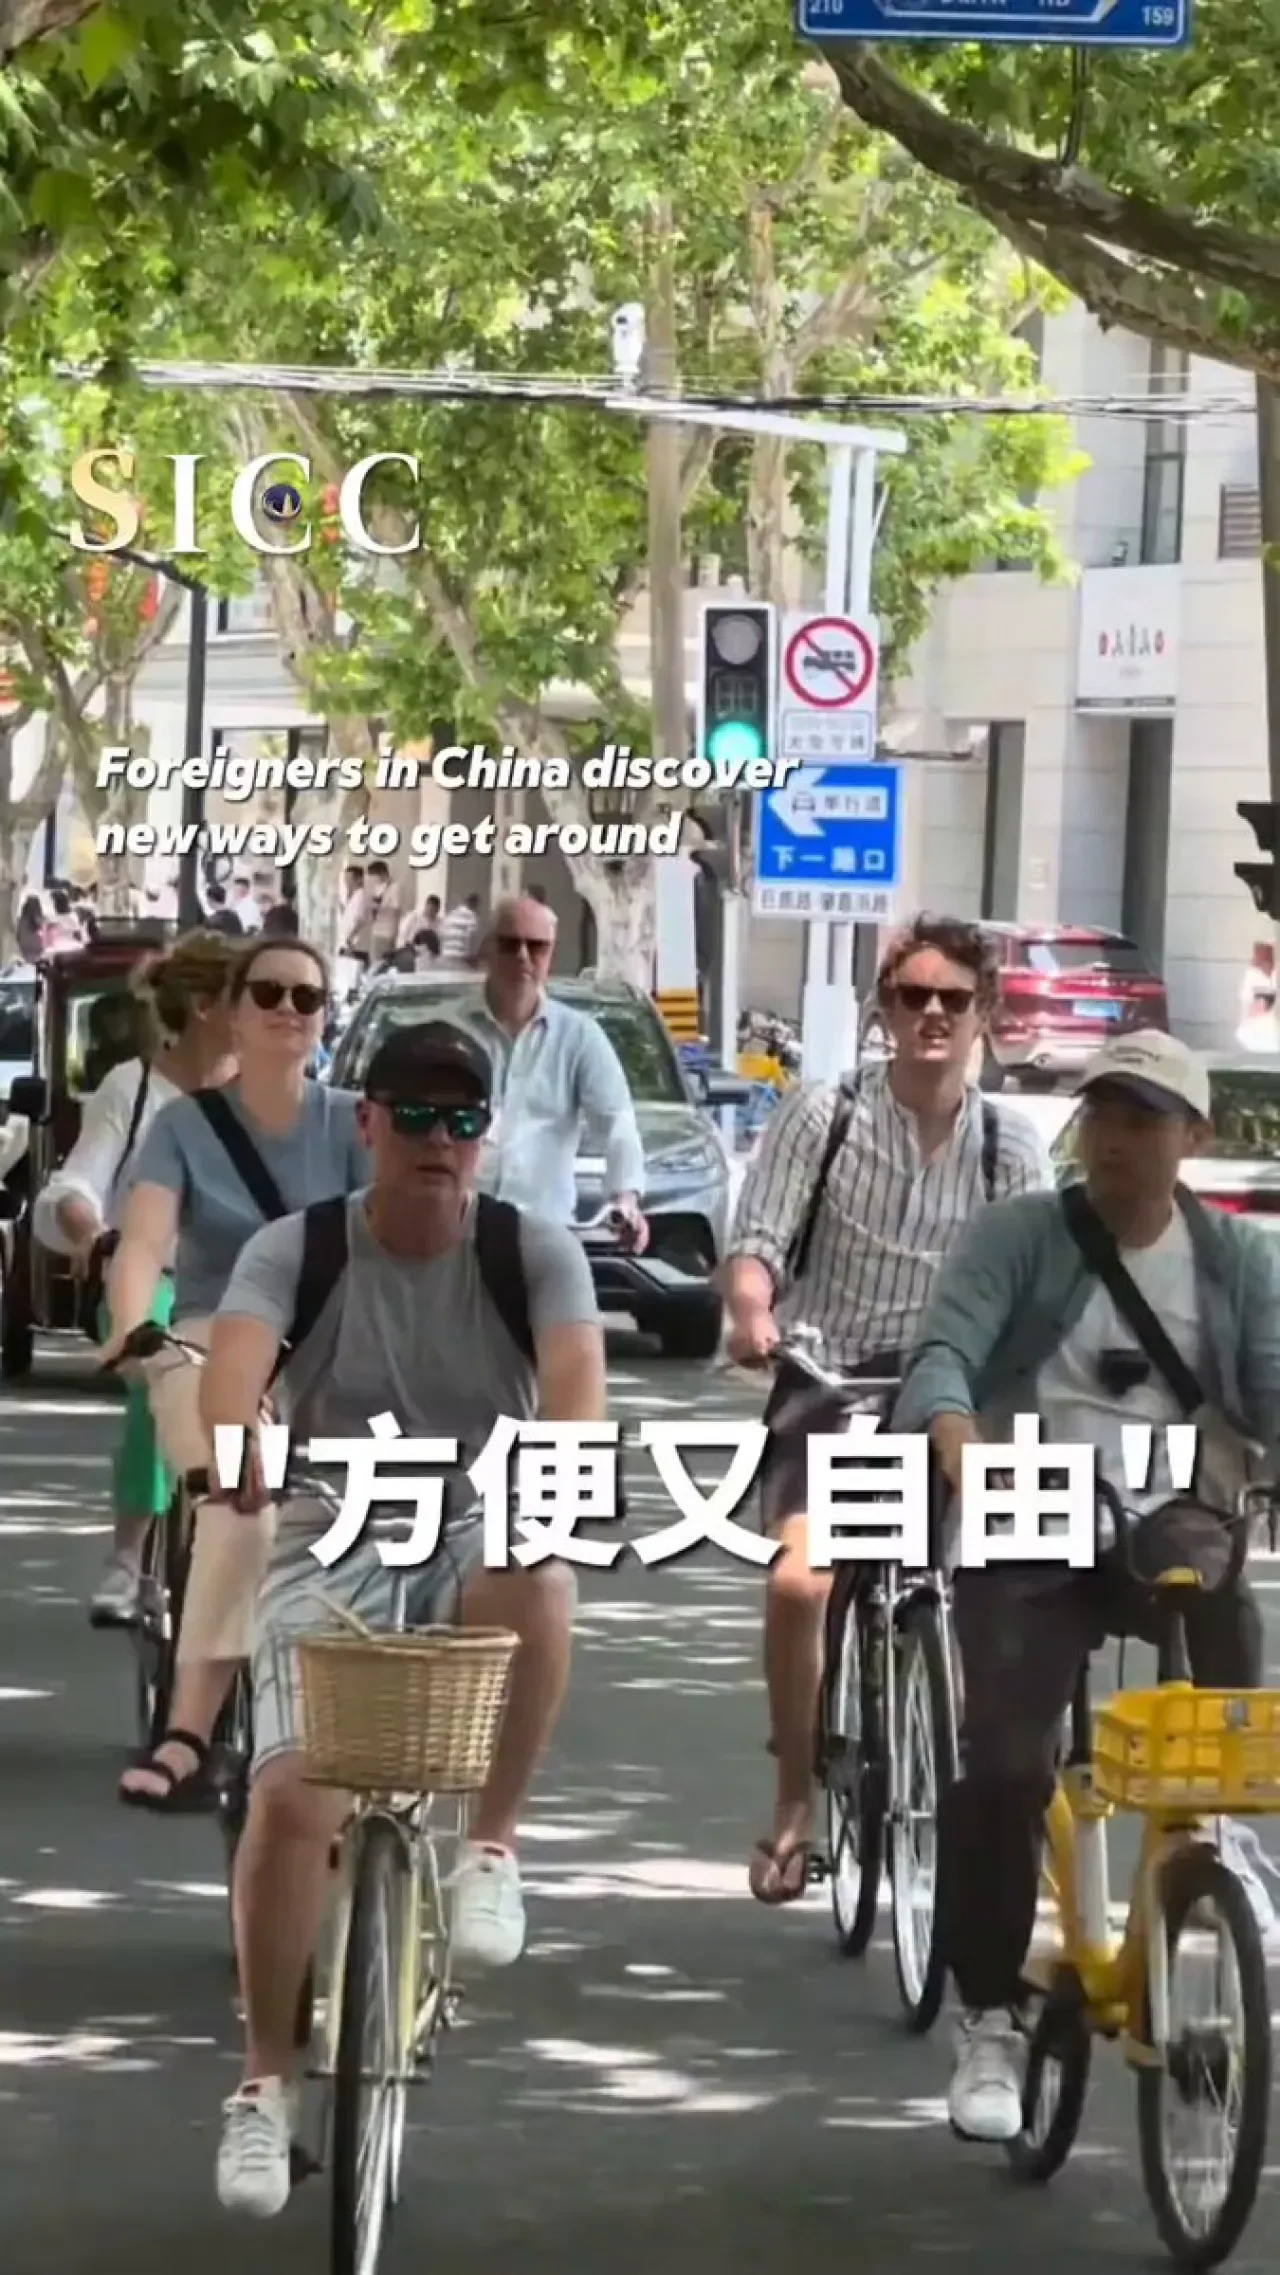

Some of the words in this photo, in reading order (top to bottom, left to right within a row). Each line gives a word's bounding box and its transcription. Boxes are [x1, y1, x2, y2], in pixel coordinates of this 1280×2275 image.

[1142, 6, 1175, 26] 159
[771, 845, 886, 873] 下一路口
